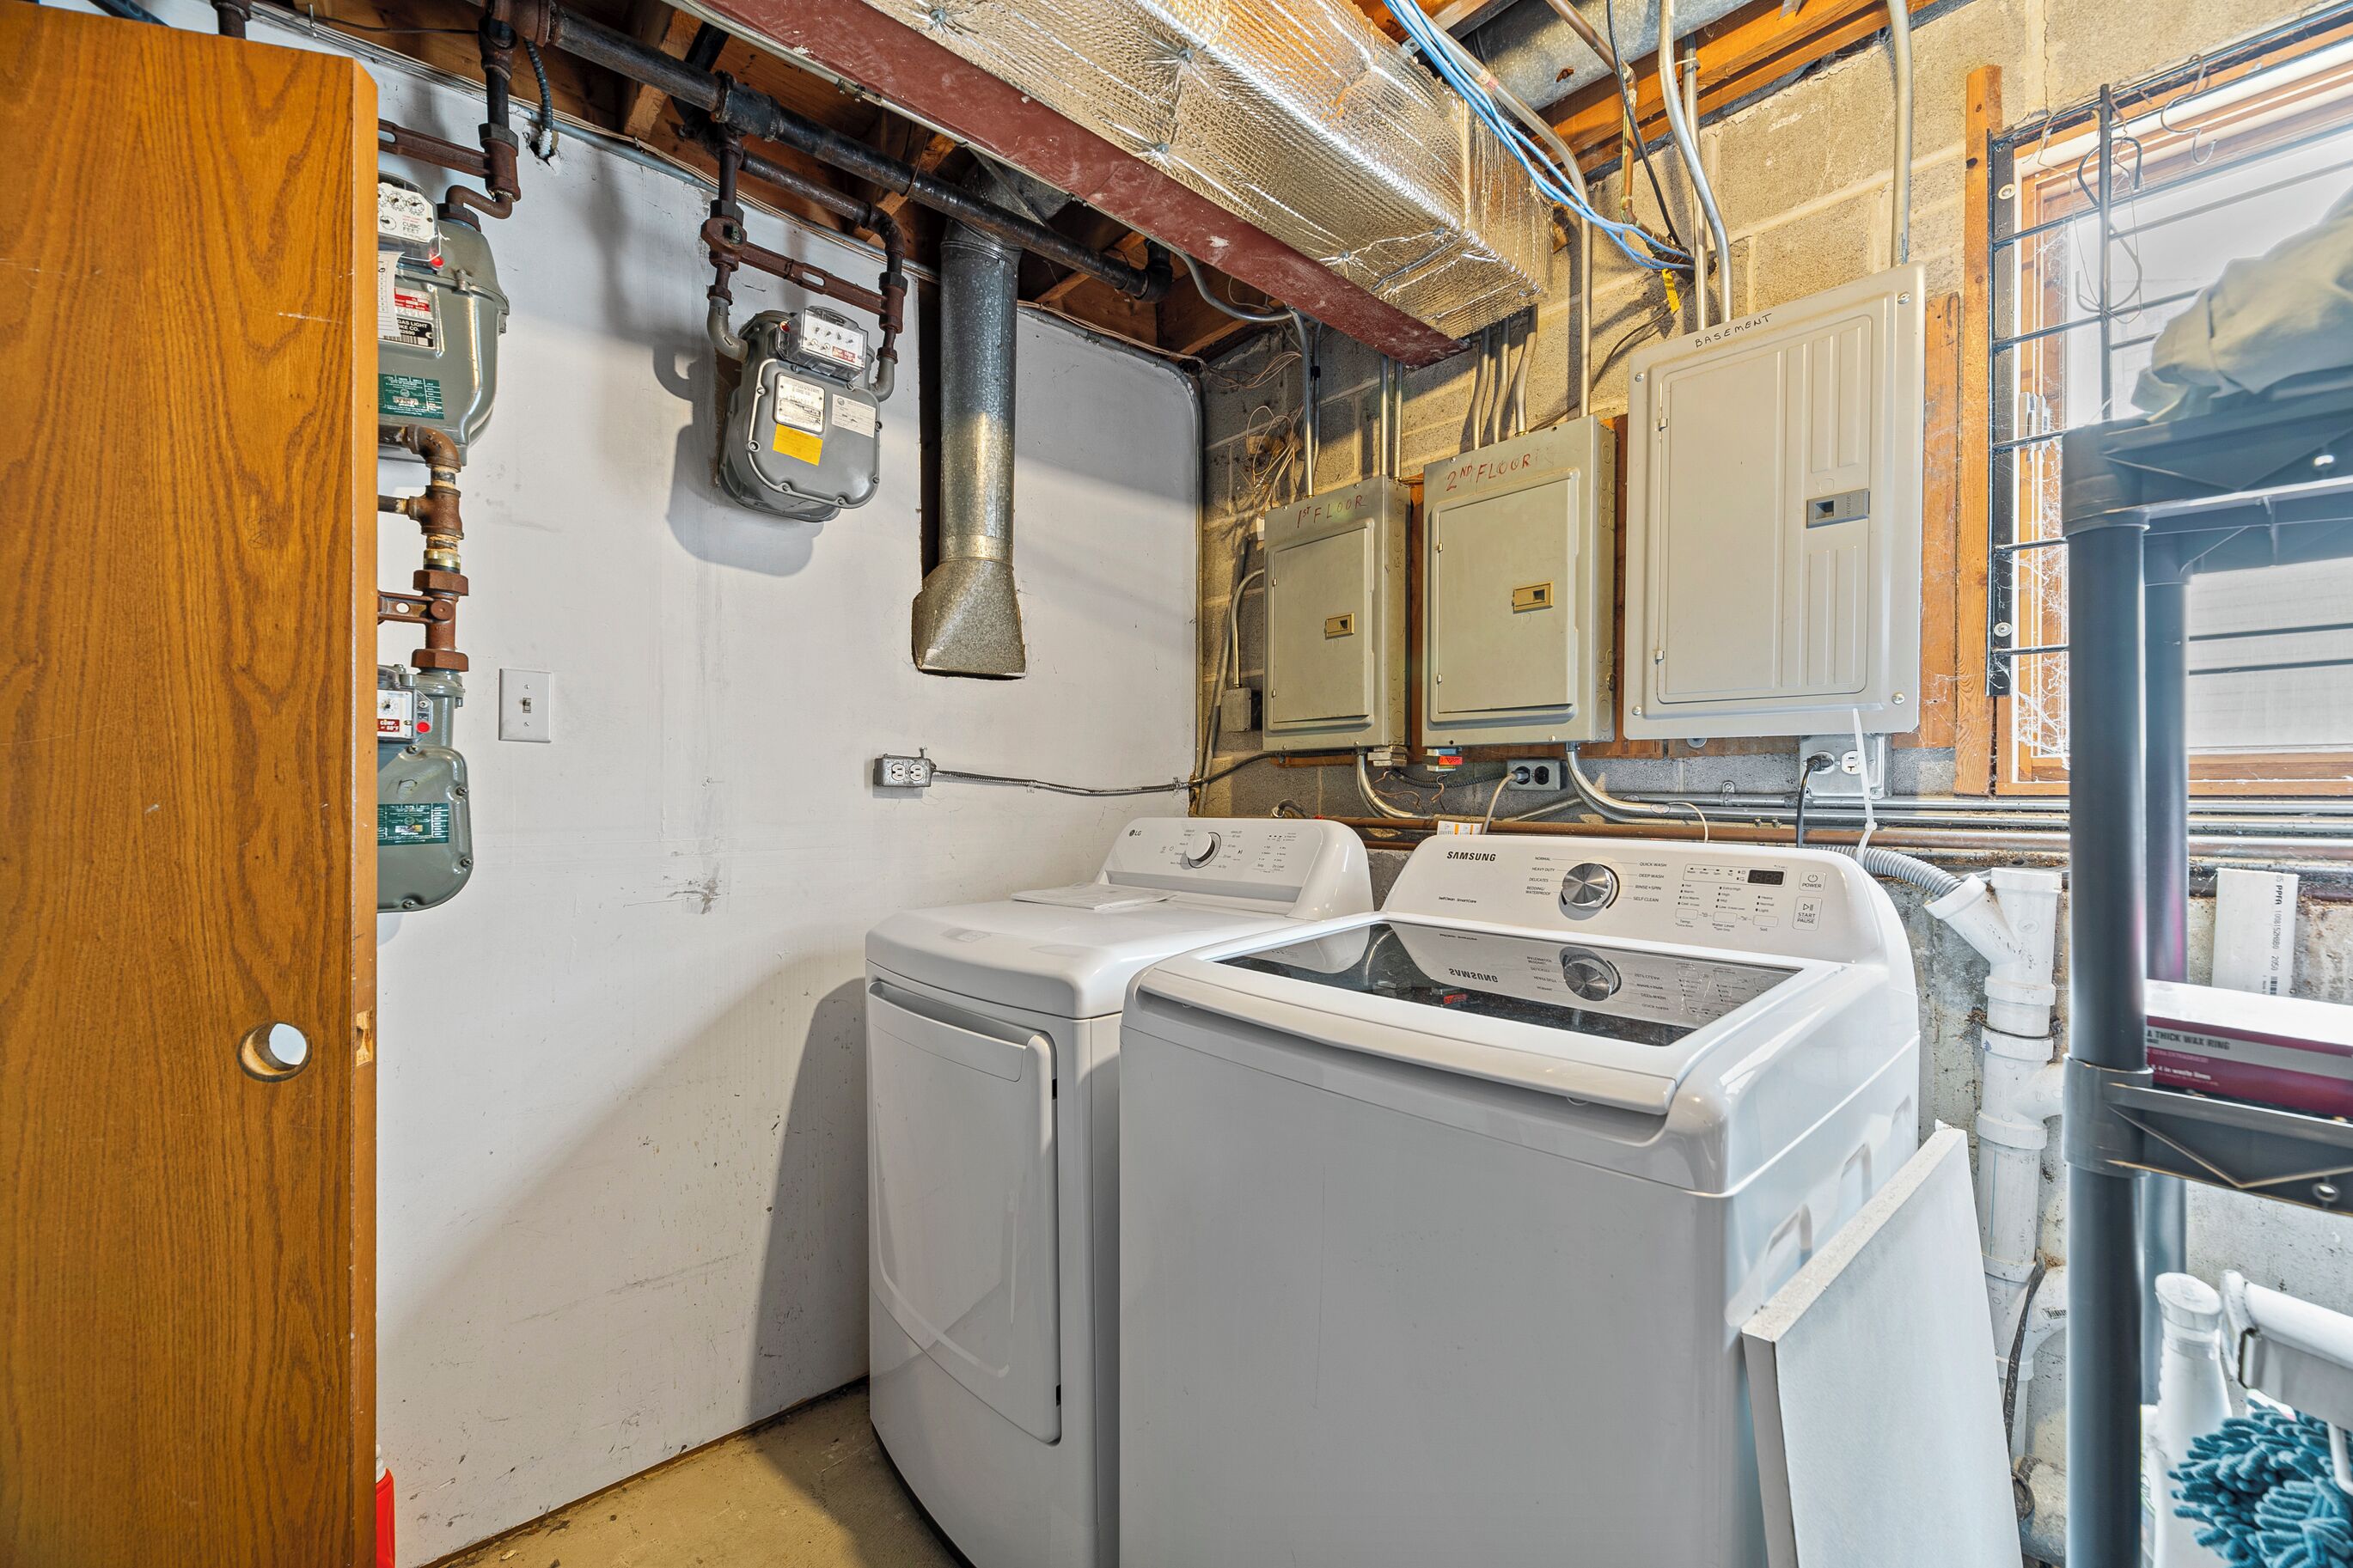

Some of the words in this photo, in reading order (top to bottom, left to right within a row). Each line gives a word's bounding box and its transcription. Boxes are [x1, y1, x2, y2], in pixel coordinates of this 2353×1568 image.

[410, 320, 428, 329] LIGHT
[1695, 313, 1772, 348] BASEMENT
[1476, 454, 1531, 483] FLOOR
[1313, 494, 1368, 523] FLOOR
[1446, 851, 1497, 862] SAMSUNG
[2275, 885, 2283, 905] PPFA
[2155, 1030, 2180, 1042] THICK
[2184, 1035, 2204, 1046] WAX
[2207, 1039, 2230, 1050] RING
